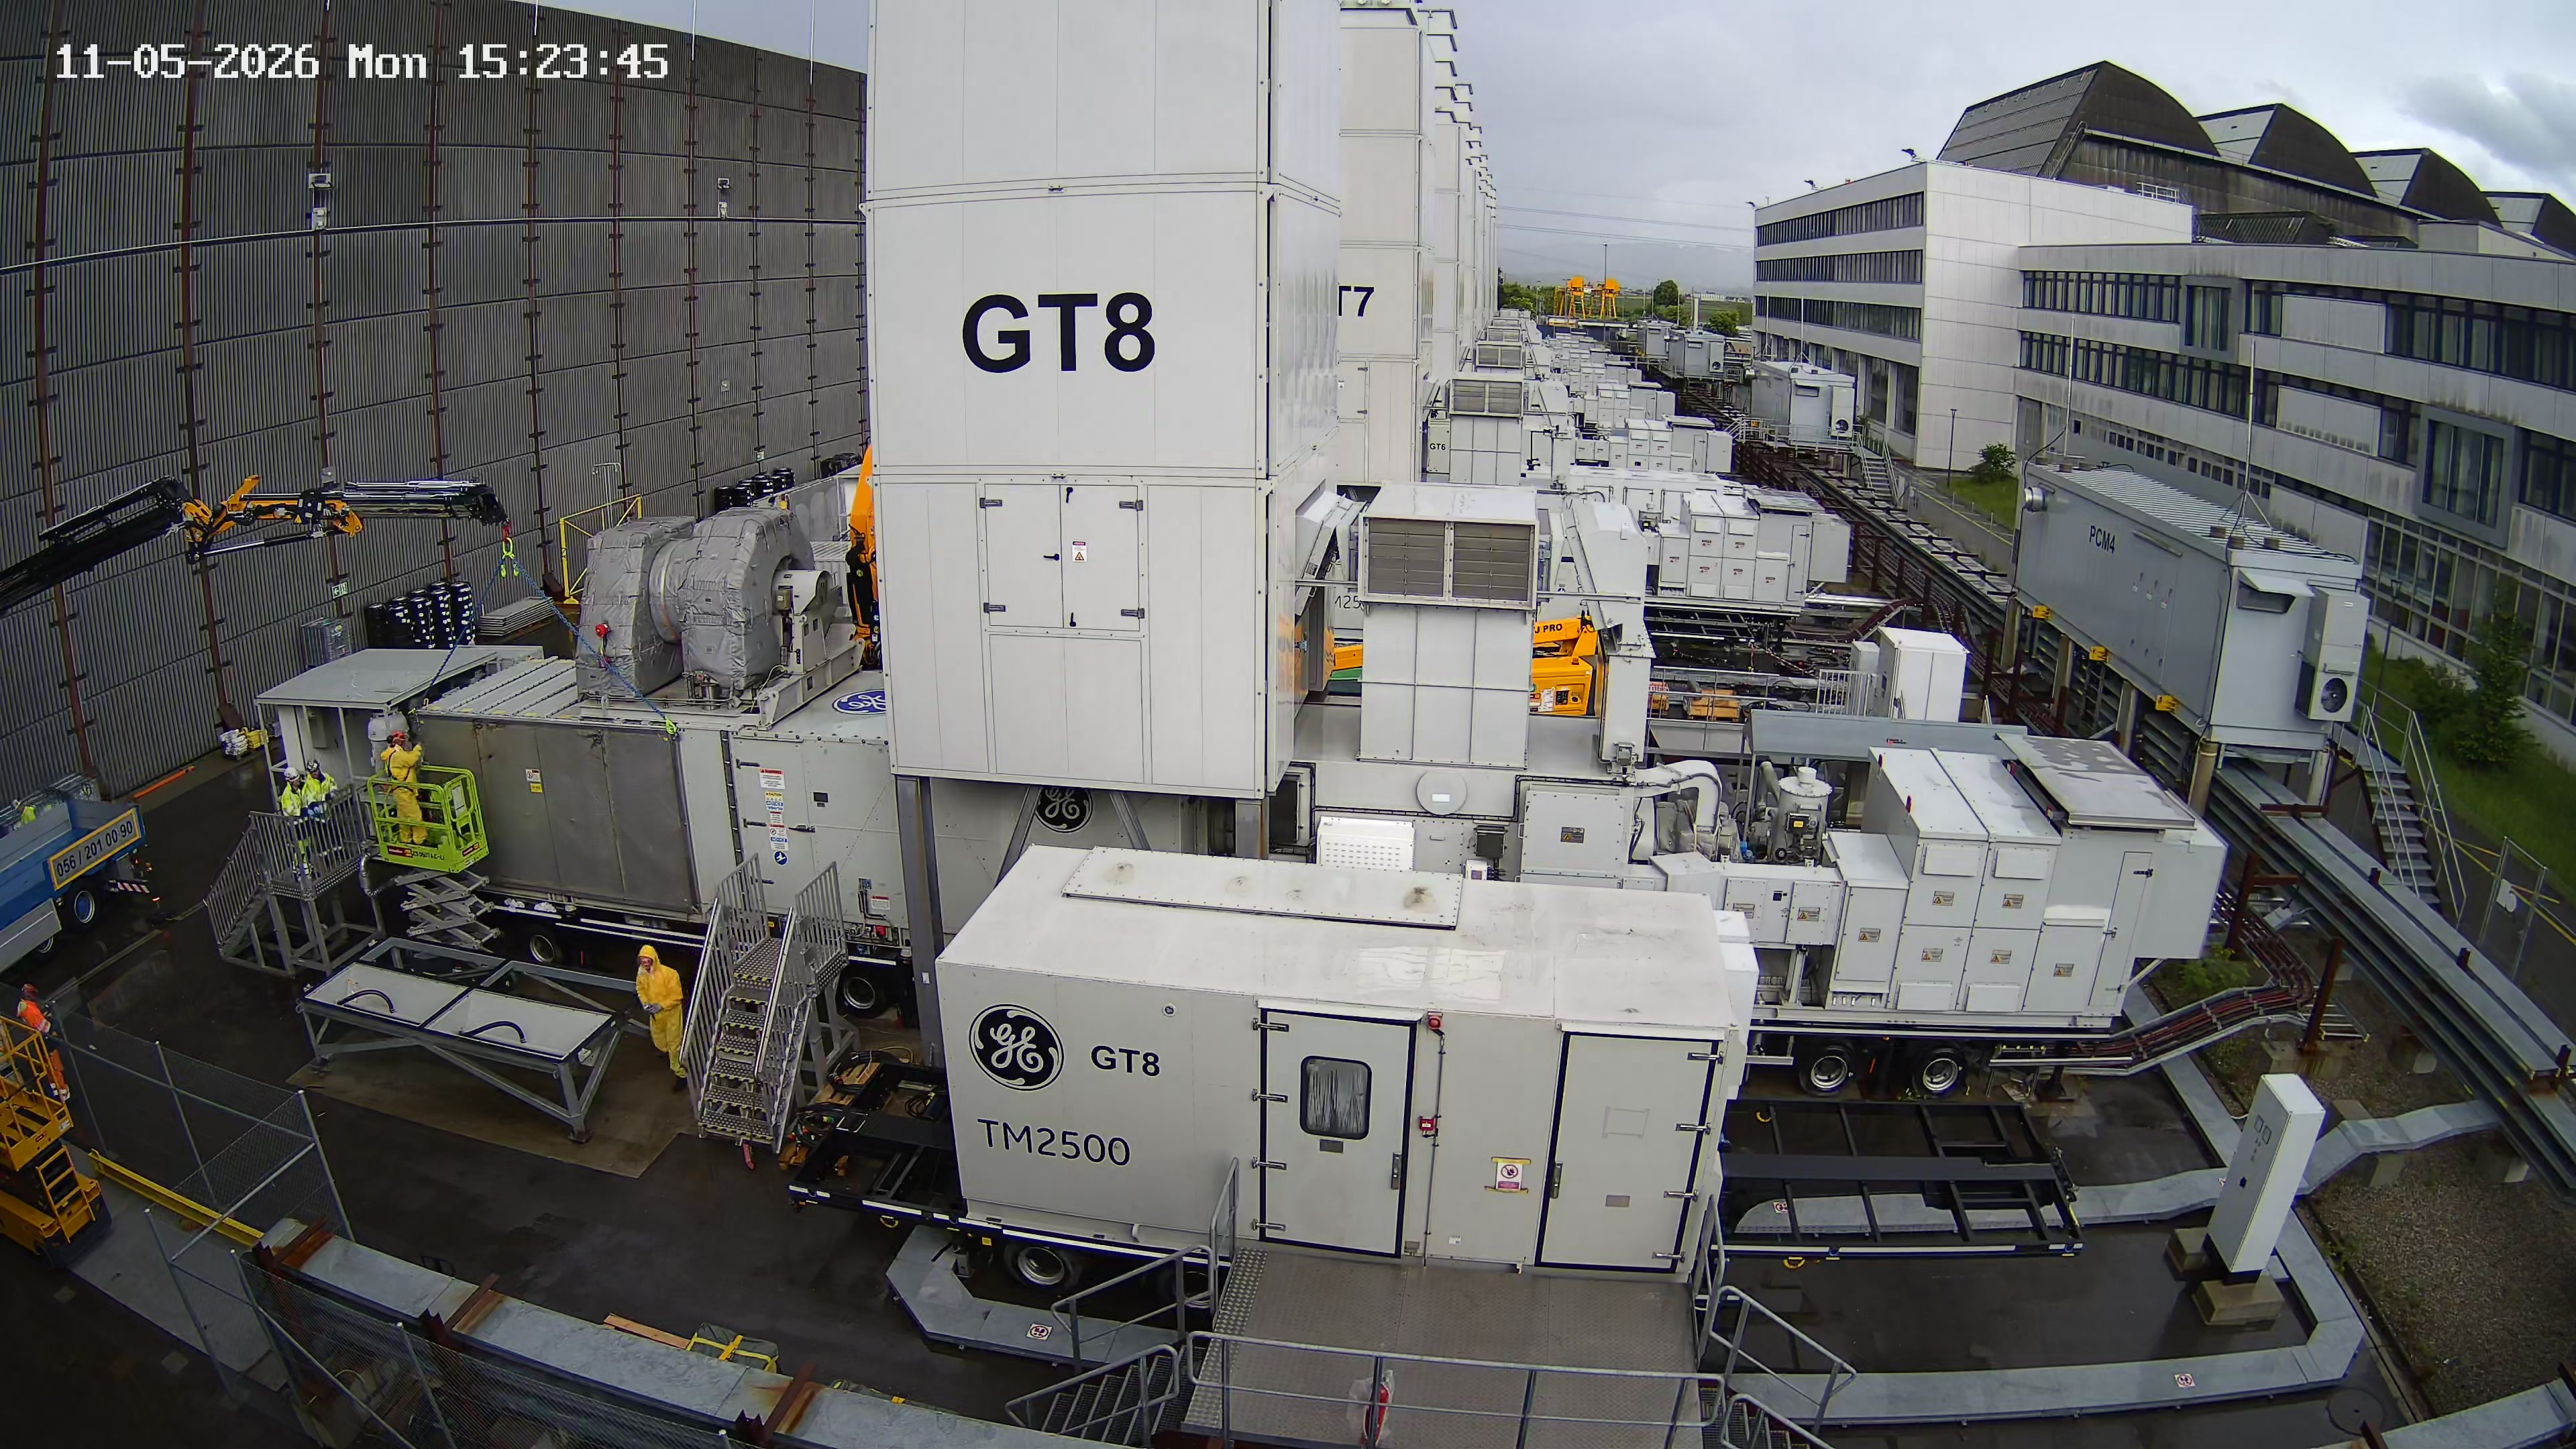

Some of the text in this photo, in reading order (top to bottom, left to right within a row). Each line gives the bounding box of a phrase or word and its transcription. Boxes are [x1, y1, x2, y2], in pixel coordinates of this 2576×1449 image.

[1338, 285, 1375, 317] T7
[963, 292, 1156, 373] GT8
[2089, 525, 2115, 554] PCM4
[1335, 595, 1364, 610] 125
[1543, 623, 1562, 633] PRO
[56, 855, 76, 877] 056
[85, 839, 103, 859] 201
[105, 830, 118, 847] 00
[119, 820, 133, 838] 90
[1091, 1045, 1160, 1077] GT8
[977, 1118, 1130, 1166] TM2500
